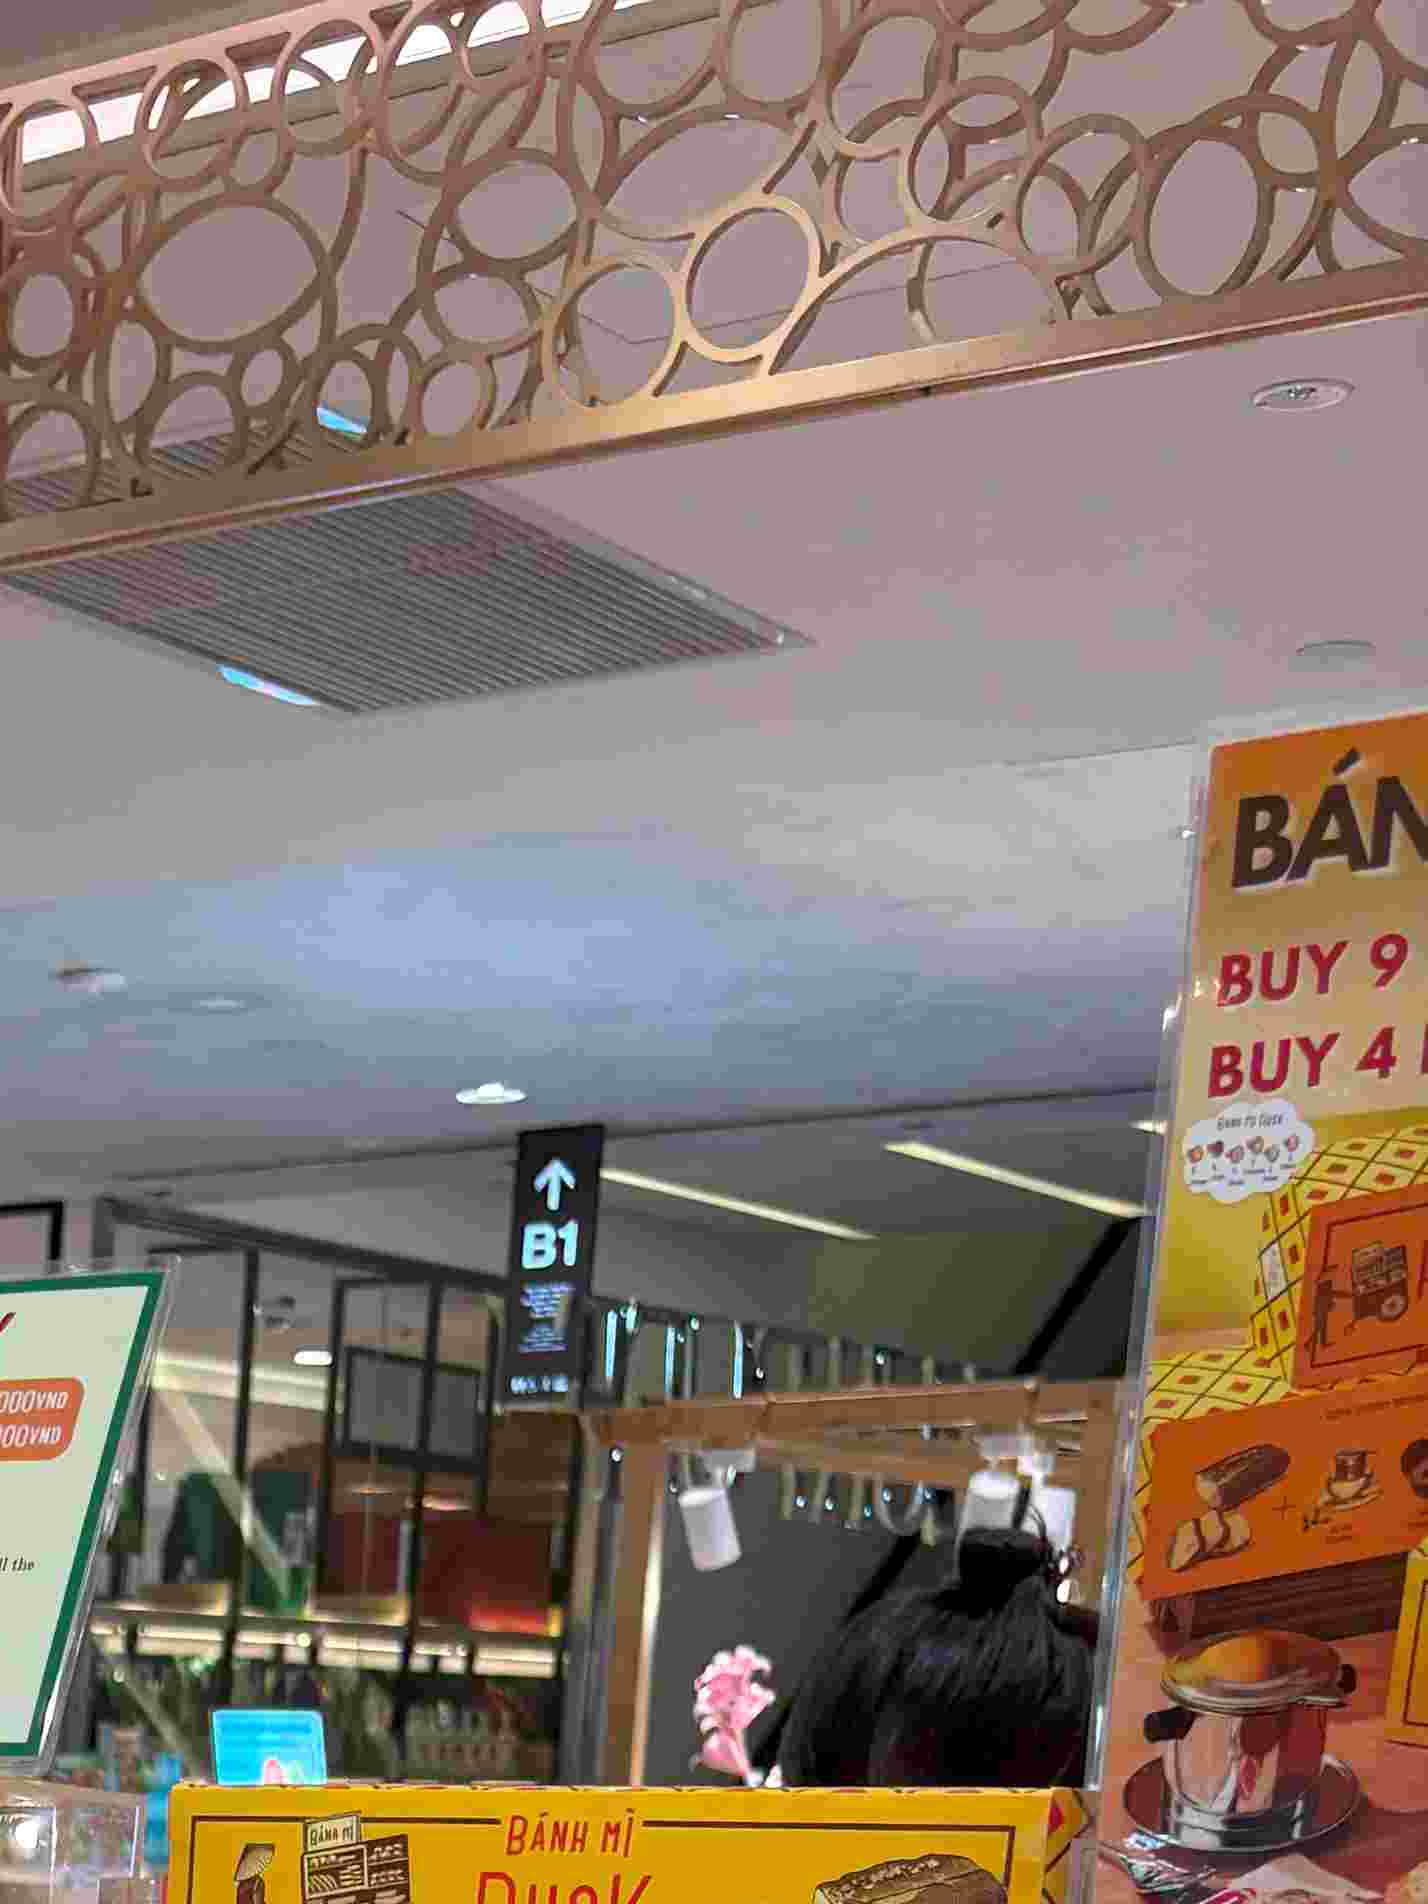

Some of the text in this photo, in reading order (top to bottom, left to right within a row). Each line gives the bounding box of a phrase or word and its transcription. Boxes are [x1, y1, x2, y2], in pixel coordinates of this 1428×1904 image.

[1216, 931, 1410, 1007] BUY 9
[1207, 1024, 1397, 1098] BUY 4
[521, 1220, 579, 1270] B1
[12, 1556, 35, 1572] the
[505, 1808, 635, 1858] BÁNH MÌ
